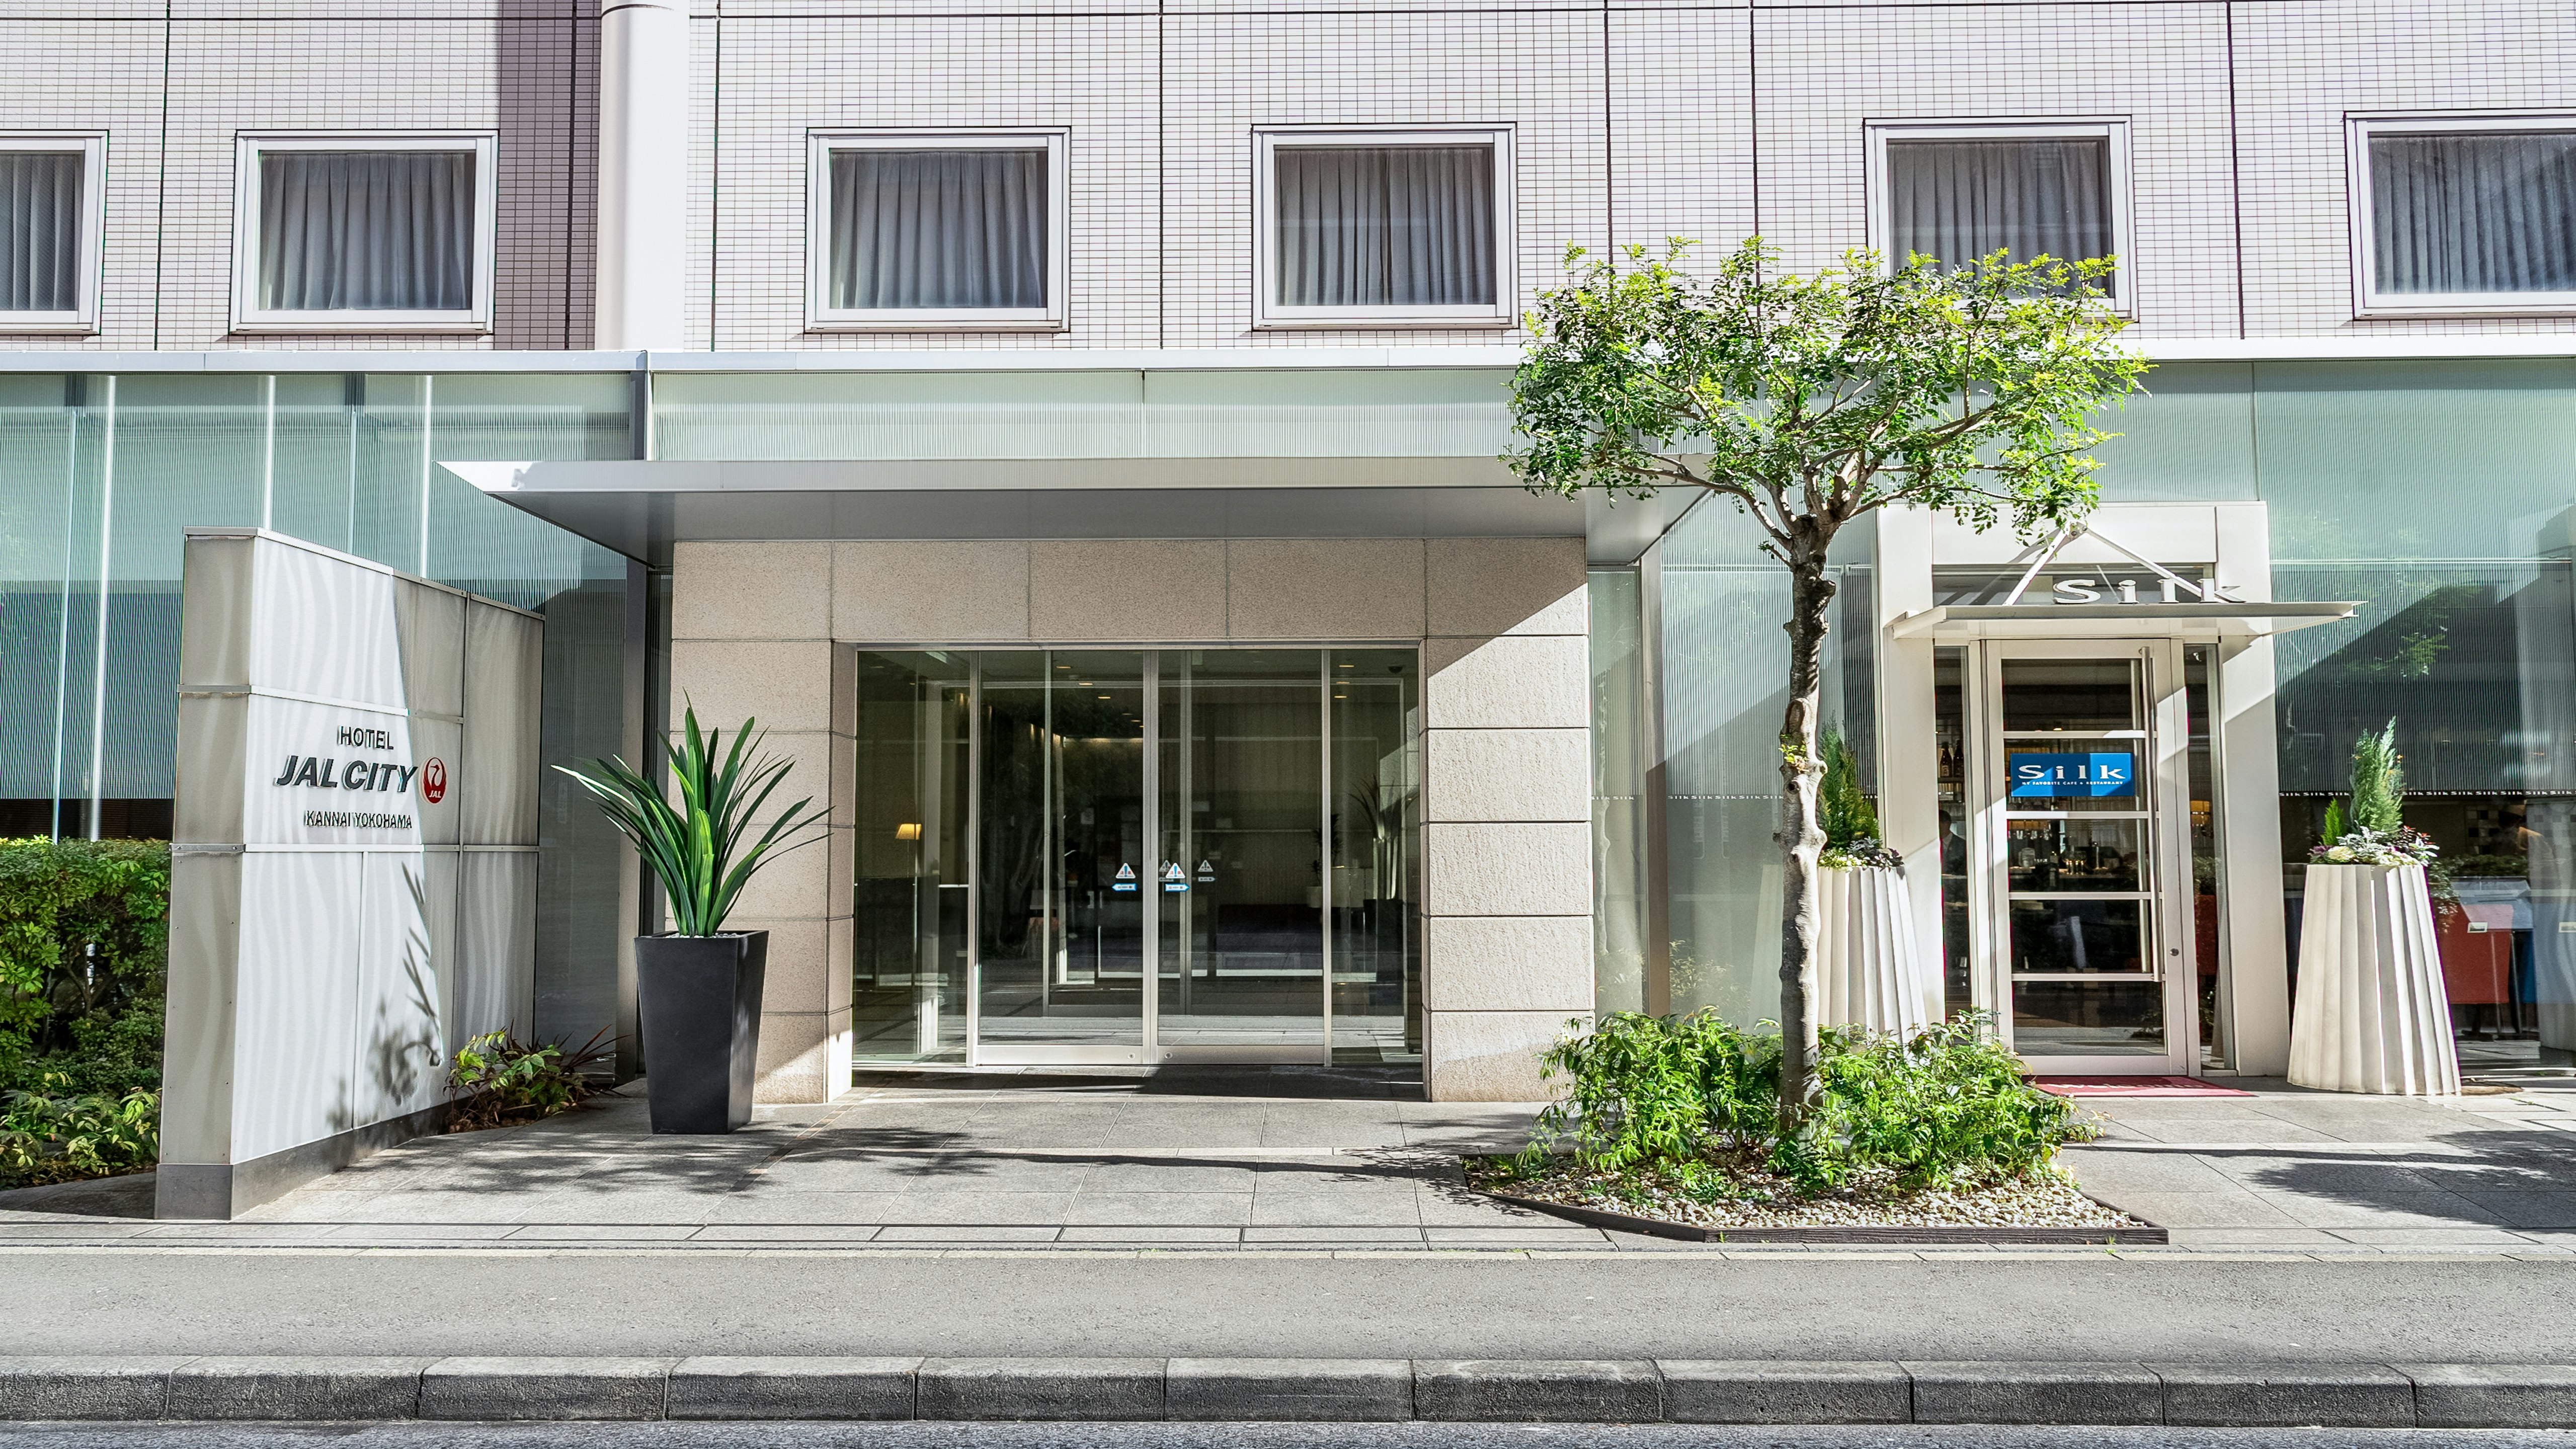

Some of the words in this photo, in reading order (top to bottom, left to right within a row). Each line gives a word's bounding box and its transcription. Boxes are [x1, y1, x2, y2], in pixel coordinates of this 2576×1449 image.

[2052, 578, 2246, 604] Silk
[337, 726, 394, 750] HOTEL
[274, 755, 338, 788] JAL
[342, 760, 419, 793] CITY
[2018, 765, 2126, 779] Silk
[429, 790, 442, 798] JAL
[304, 810, 351, 826] KANNAI
[353, 812, 412, 829] YOKOHAMA
